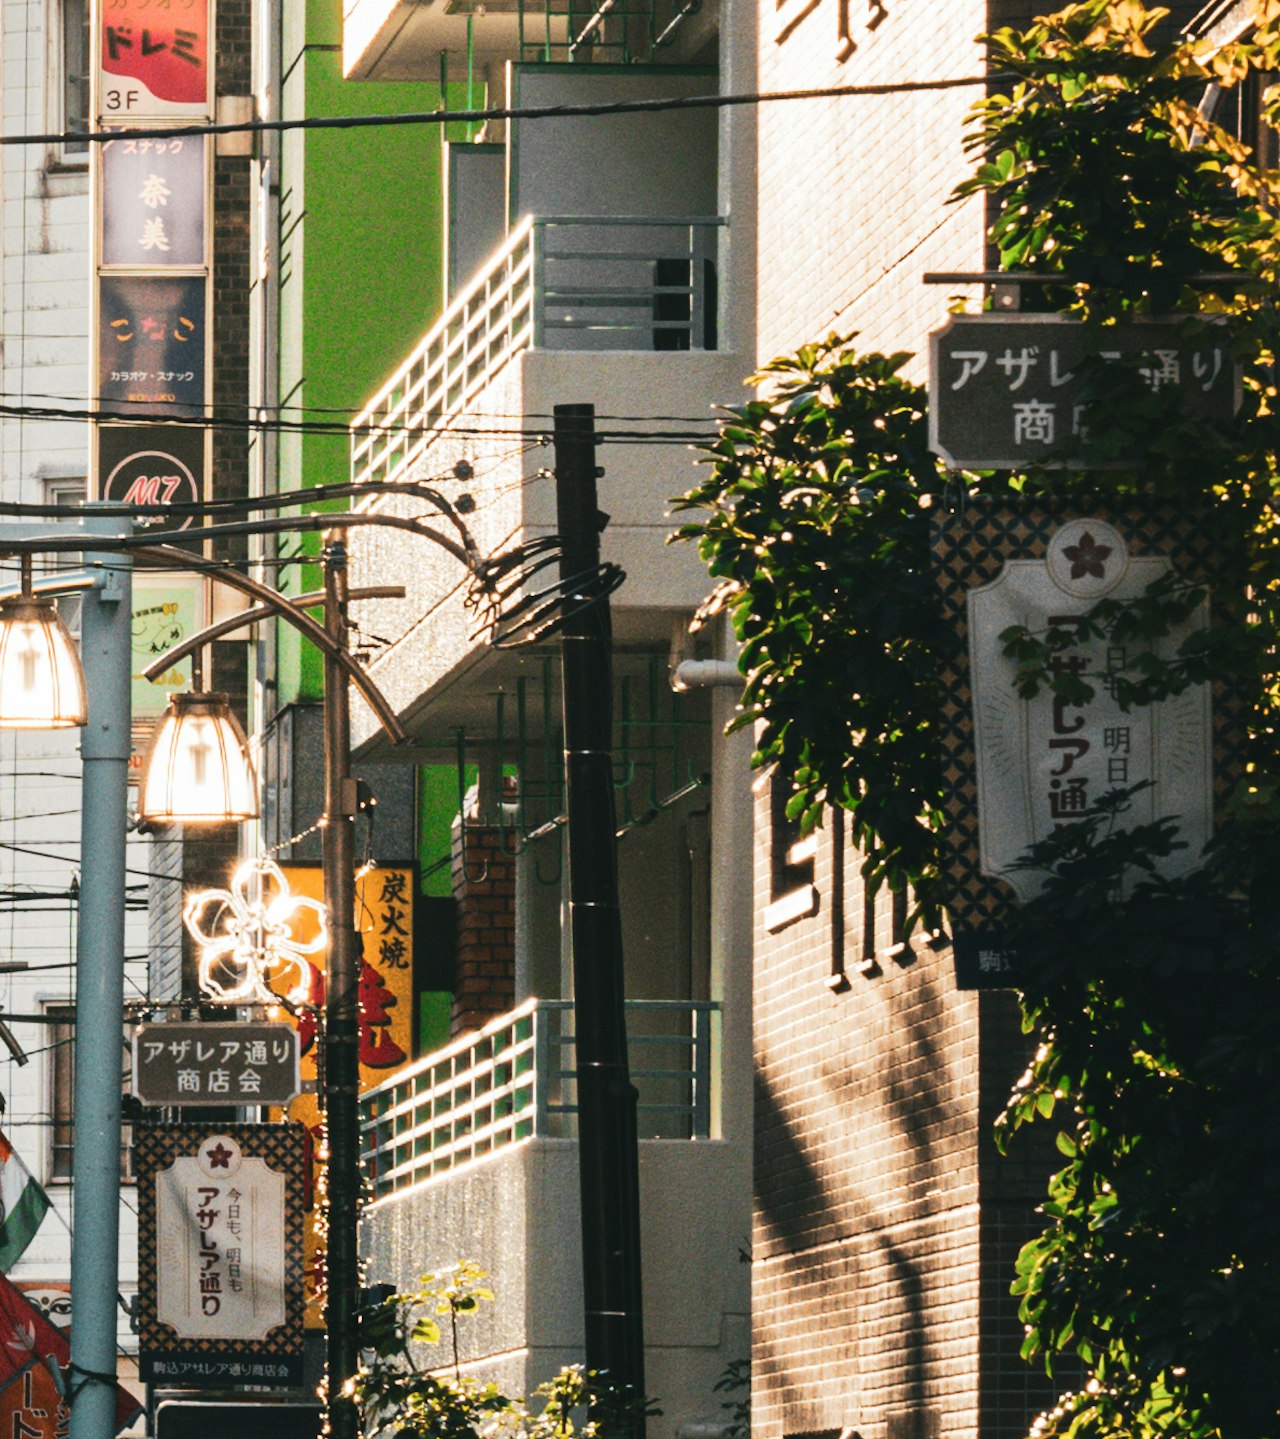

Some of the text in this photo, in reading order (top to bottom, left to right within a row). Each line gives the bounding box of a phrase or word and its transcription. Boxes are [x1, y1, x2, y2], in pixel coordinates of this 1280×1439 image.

[105, 25, 203, 69] ドレミ
[106, 89, 139, 110] 3F
[122, 140, 184, 154] スナック
[138, 173, 172, 251] 奈美
[378, 870, 410, 970] 炭火焼
[143, 1039, 290, 1066] アザレア通り
[177, 1068, 262, 1094] 商店会
[195, 1186, 222, 1317] アザレア通り
[153, 1360, 289, 1378] 駒込アザレア通り商店会
